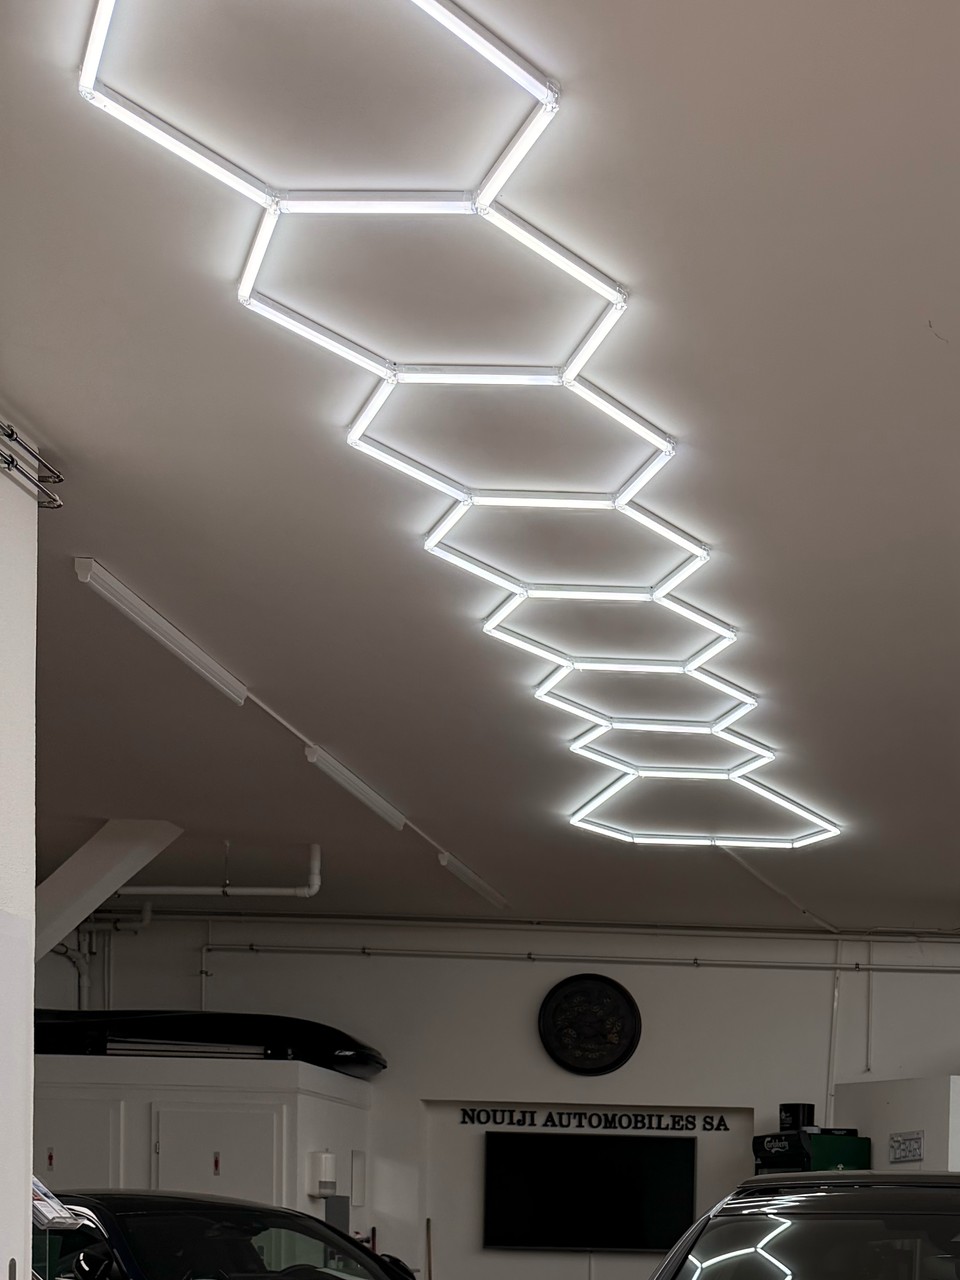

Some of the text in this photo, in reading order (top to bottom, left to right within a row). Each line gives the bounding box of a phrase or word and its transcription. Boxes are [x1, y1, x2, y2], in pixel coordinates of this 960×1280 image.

[460, 1108, 730, 1132] NOUIJI AUTOMOBILES SA
[764, 1137, 789, 1153] Carlsberg
